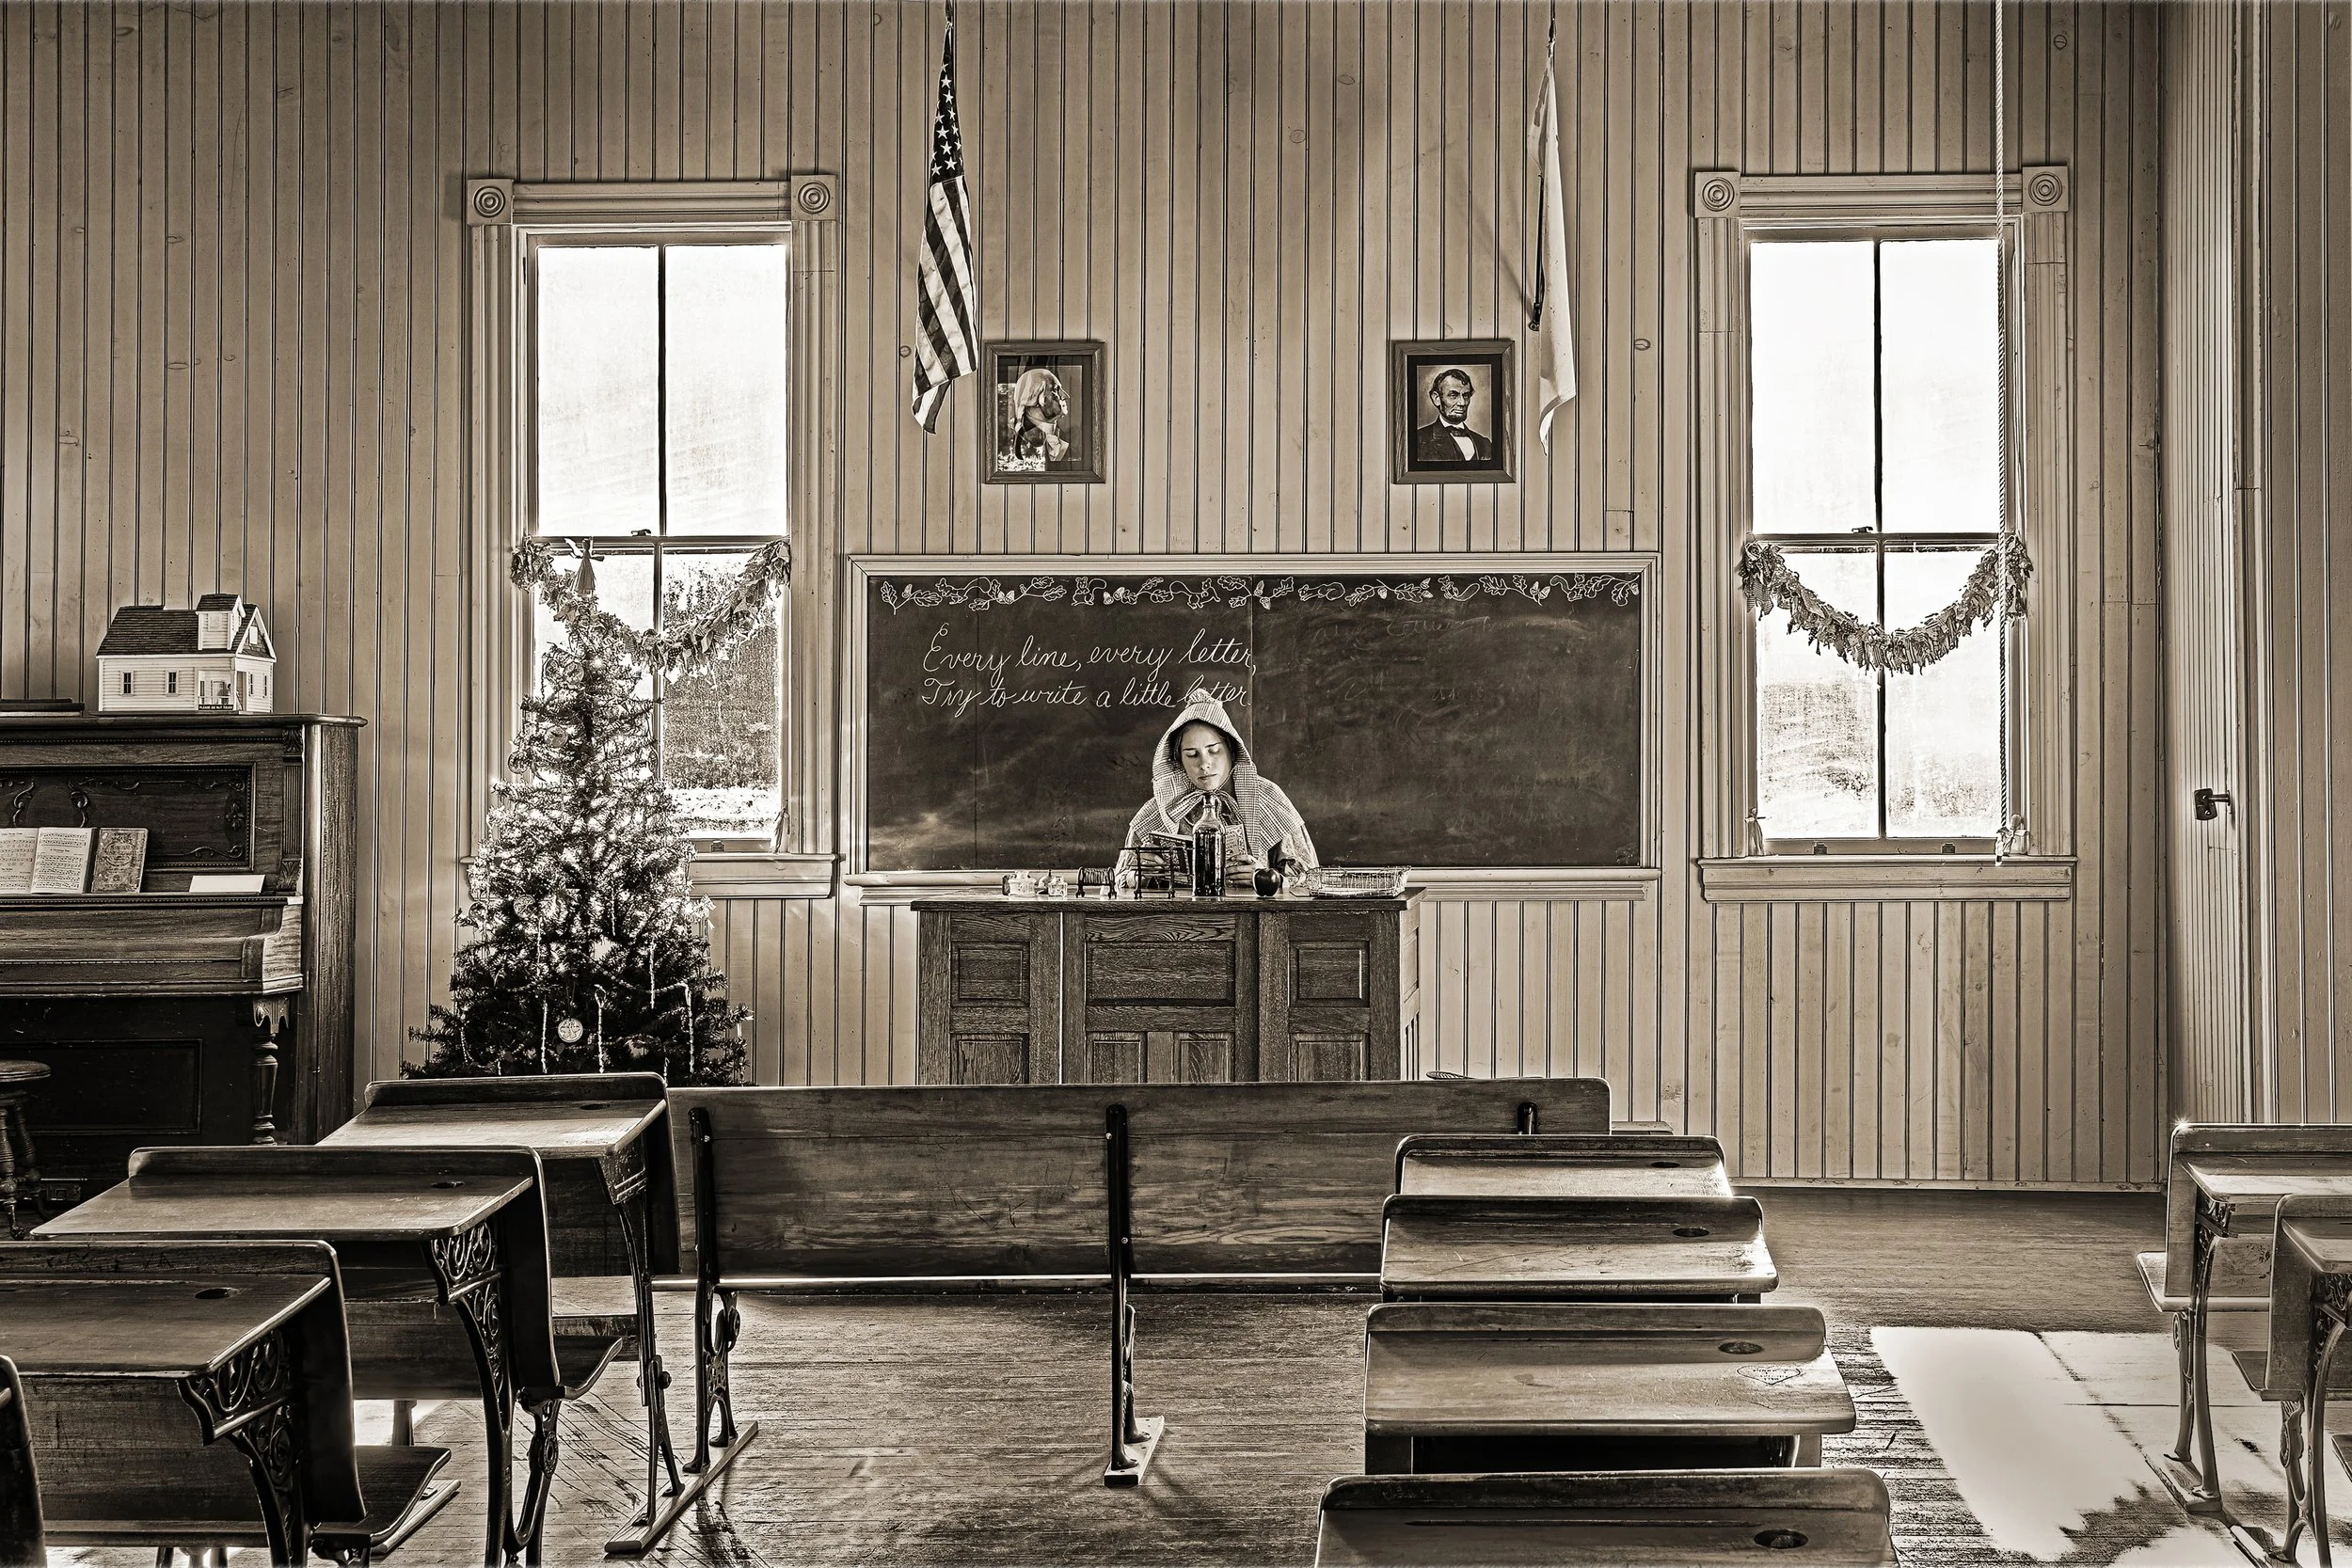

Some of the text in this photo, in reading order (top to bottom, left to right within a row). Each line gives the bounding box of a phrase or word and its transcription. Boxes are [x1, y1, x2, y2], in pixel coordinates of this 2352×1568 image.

[923, 622, 1257, 688] Every line, every letter,
[922, 674, 1251, 718] Try to write a little btter.
